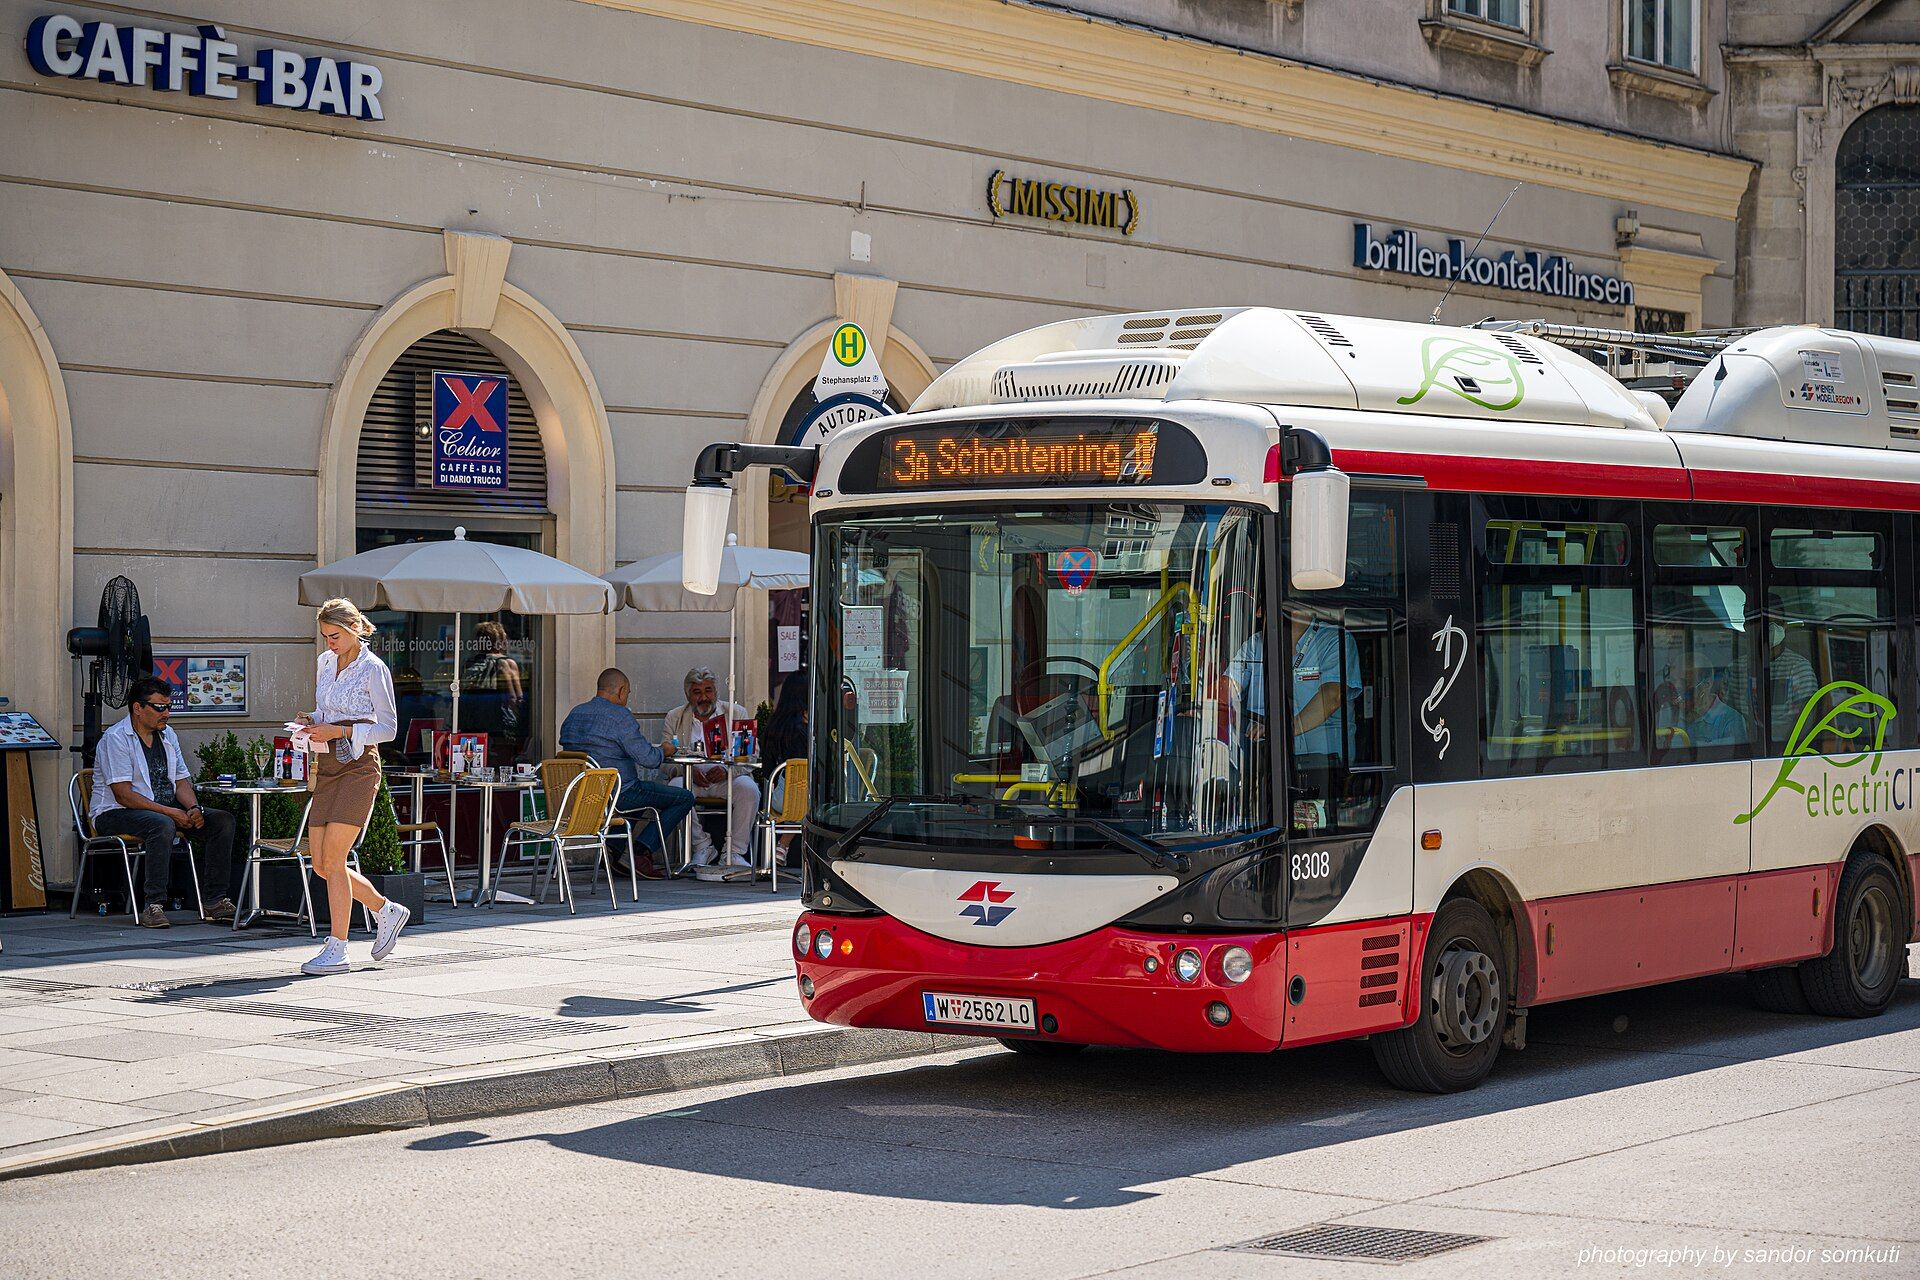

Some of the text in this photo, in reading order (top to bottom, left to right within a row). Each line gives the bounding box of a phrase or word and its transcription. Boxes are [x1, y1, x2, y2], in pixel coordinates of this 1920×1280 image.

[26, 14, 385, 121] CAFFÈ-BAR
[1010, 178, 1119, 228] MISSIMI
[1354, 224, 1635, 304] brillen-kontaktlinsen
[841, 332, 858, 358] H
[822, 375, 871, 385] Stephansplatz
[1815, 384, 1835, 394] WIENER
[441, 377, 502, 432] X
[1816, 394, 1855, 404] MODELLREGION
[817, 407, 880, 438] AUTOB
[440, 430, 501, 457] Celsior
[937, 433, 1121, 476] Schottenring
[440, 462, 501, 474] CAFFÈ-BAR
[440, 475, 501, 485] DI DARIO TRUCCO
[381, 636, 405, 651] latte
[409, 636, 464, 651] cioccolaa
[466, 635, 493, 651] caffè
[495, 637, 537, 651] corretto
[780, 631, 797, 640] SALE
[780, 652, 798, 661] -50%
[1291, 851, 1330, 880] 8308
[936, 997, 949, 1018] W
[962, 1000, 1006, 1022] 2562
[1009, 1003, 1030, 1024] LO
